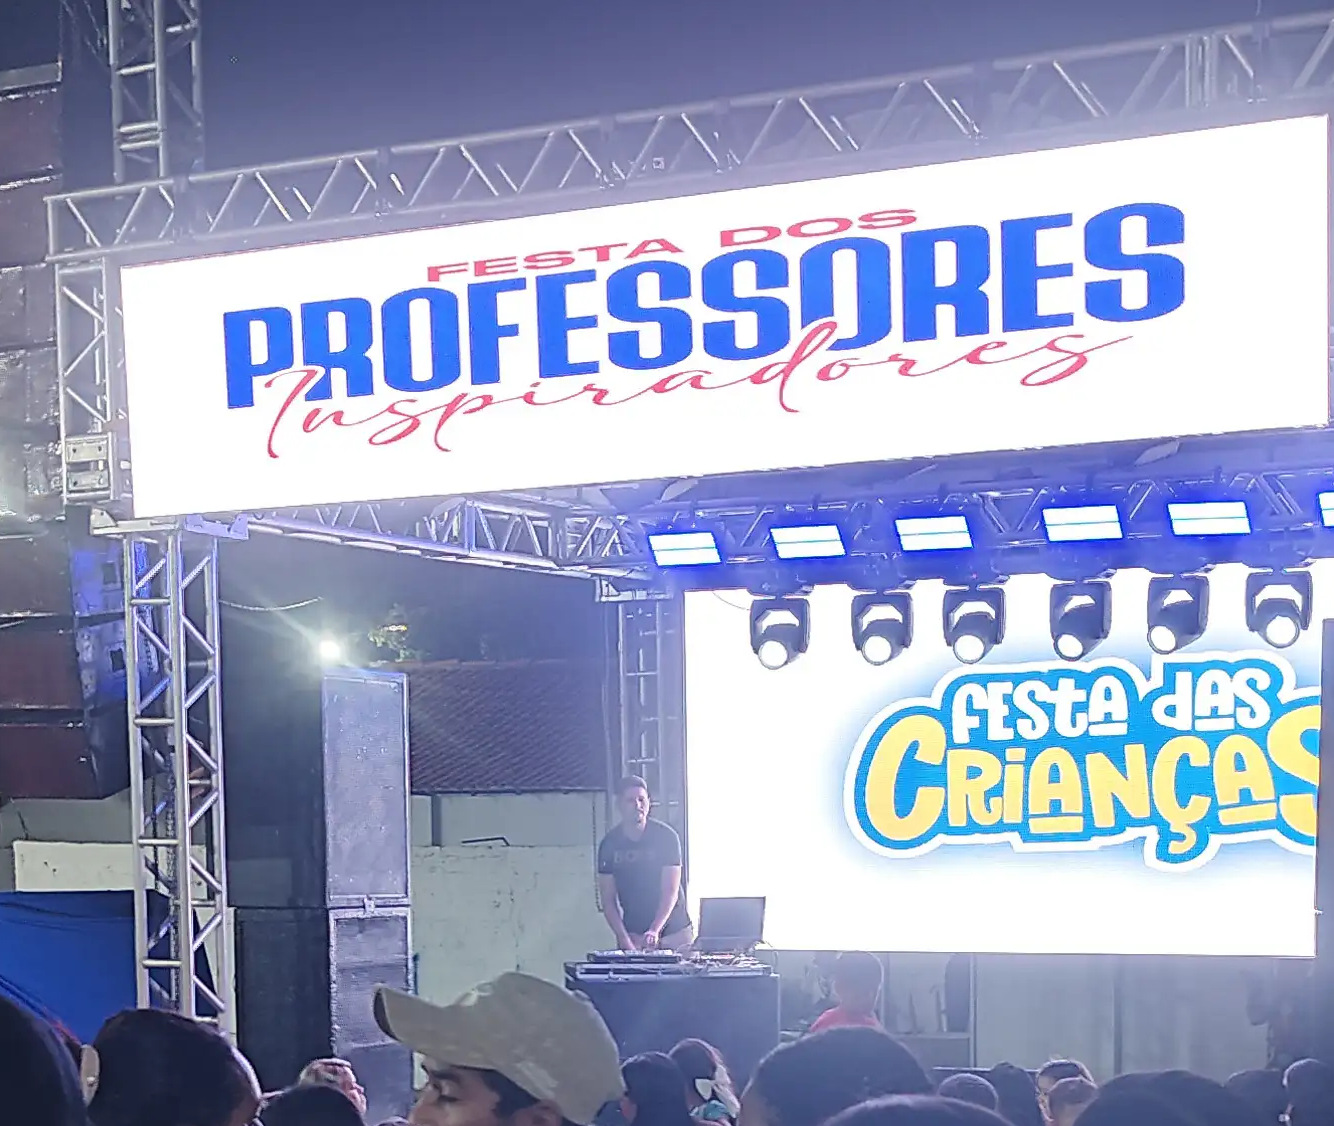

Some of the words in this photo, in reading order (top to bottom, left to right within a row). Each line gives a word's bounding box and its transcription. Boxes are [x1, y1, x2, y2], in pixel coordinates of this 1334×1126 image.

[223, 202, 1186, 410] PROFESSORES
[426, 238, 684, 283] FESTA
[720, 208, 917, 248] DOS
[264, 321, 1134, 460] Inspiradores
